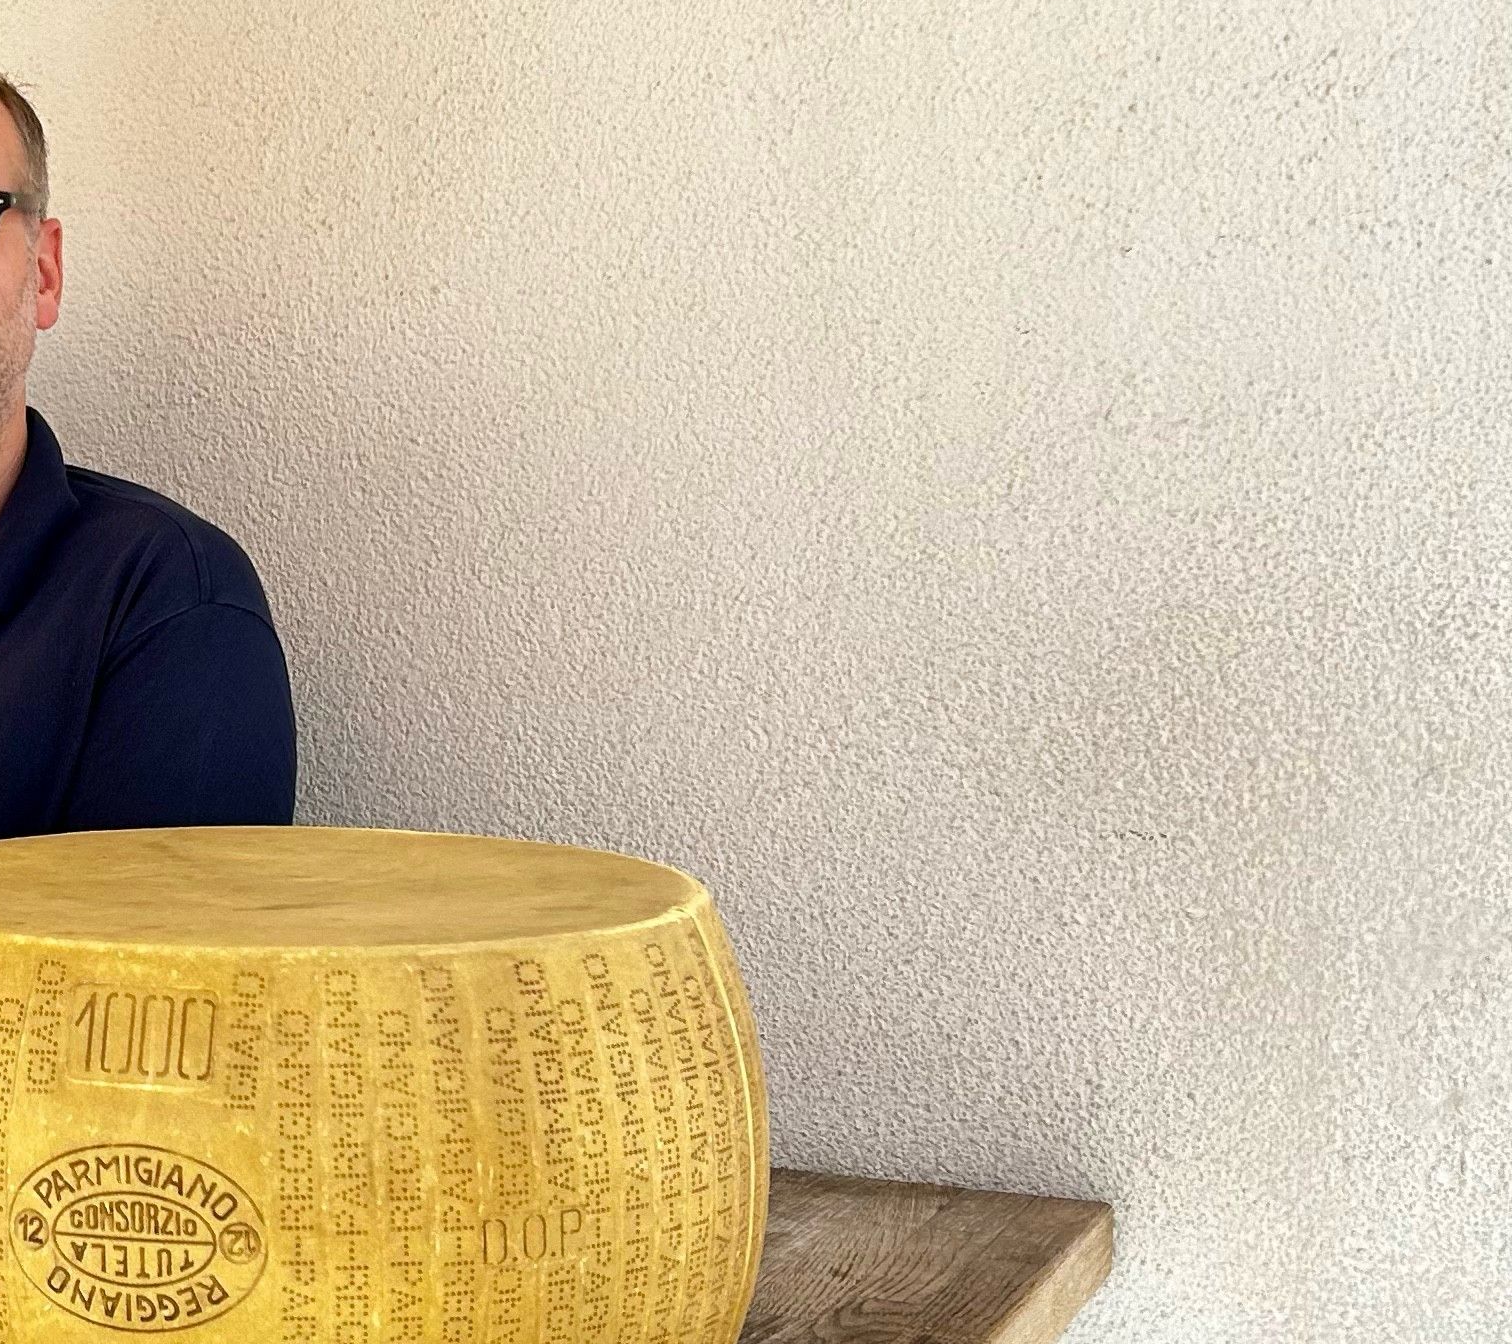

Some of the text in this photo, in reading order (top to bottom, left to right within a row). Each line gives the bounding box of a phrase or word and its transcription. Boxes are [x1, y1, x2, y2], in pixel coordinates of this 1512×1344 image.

[75, 991, 218, 1081] 1000
[33, 1155, 239, 1221] PARMIGIANO
[18, 1213, 45, 1245] 12
[69, 1200, 198, 1237] CONSORZIO
[70, 1241, 194, 1279] TUTELA
[46, 1265, 230, 1323] REGGIANO
